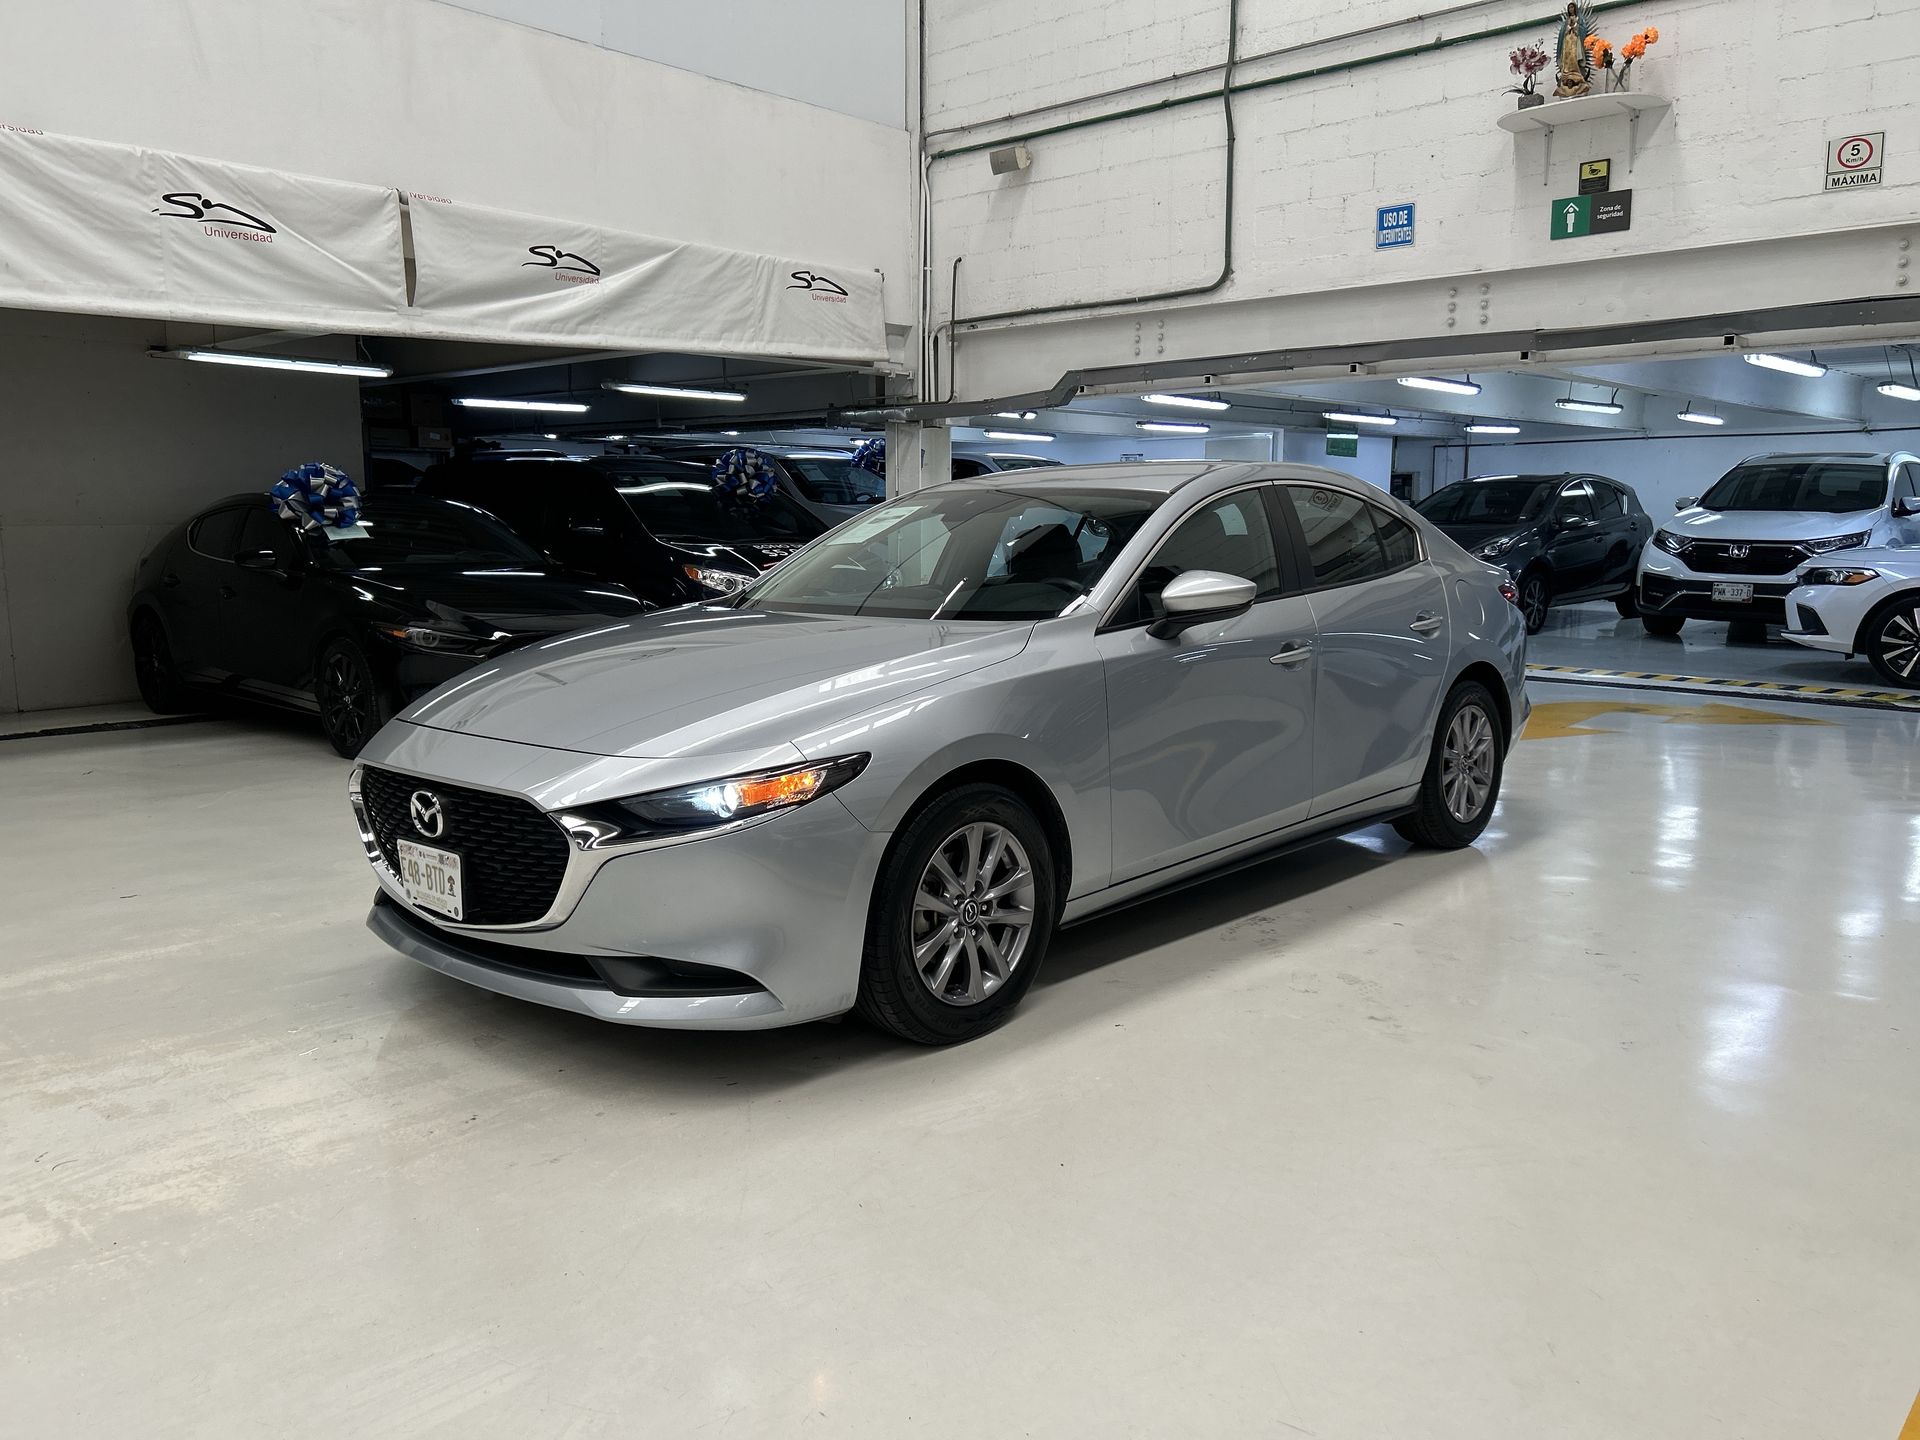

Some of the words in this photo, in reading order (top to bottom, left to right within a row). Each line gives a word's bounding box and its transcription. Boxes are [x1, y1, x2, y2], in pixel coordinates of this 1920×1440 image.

[1850, 143, 1861, 157] 5
[1831, 172, 1877, 187] MÁXIMA
[1383, 212, 1398, 228] USO
[1398, 210, 1408, 225] DE
[1597, 211, 1624, 220] seguridad
[204, 221, 273, 243] Universidad
[554, 271, 600, 285] Universidad
[811, 293, 847, 304] Universidad
